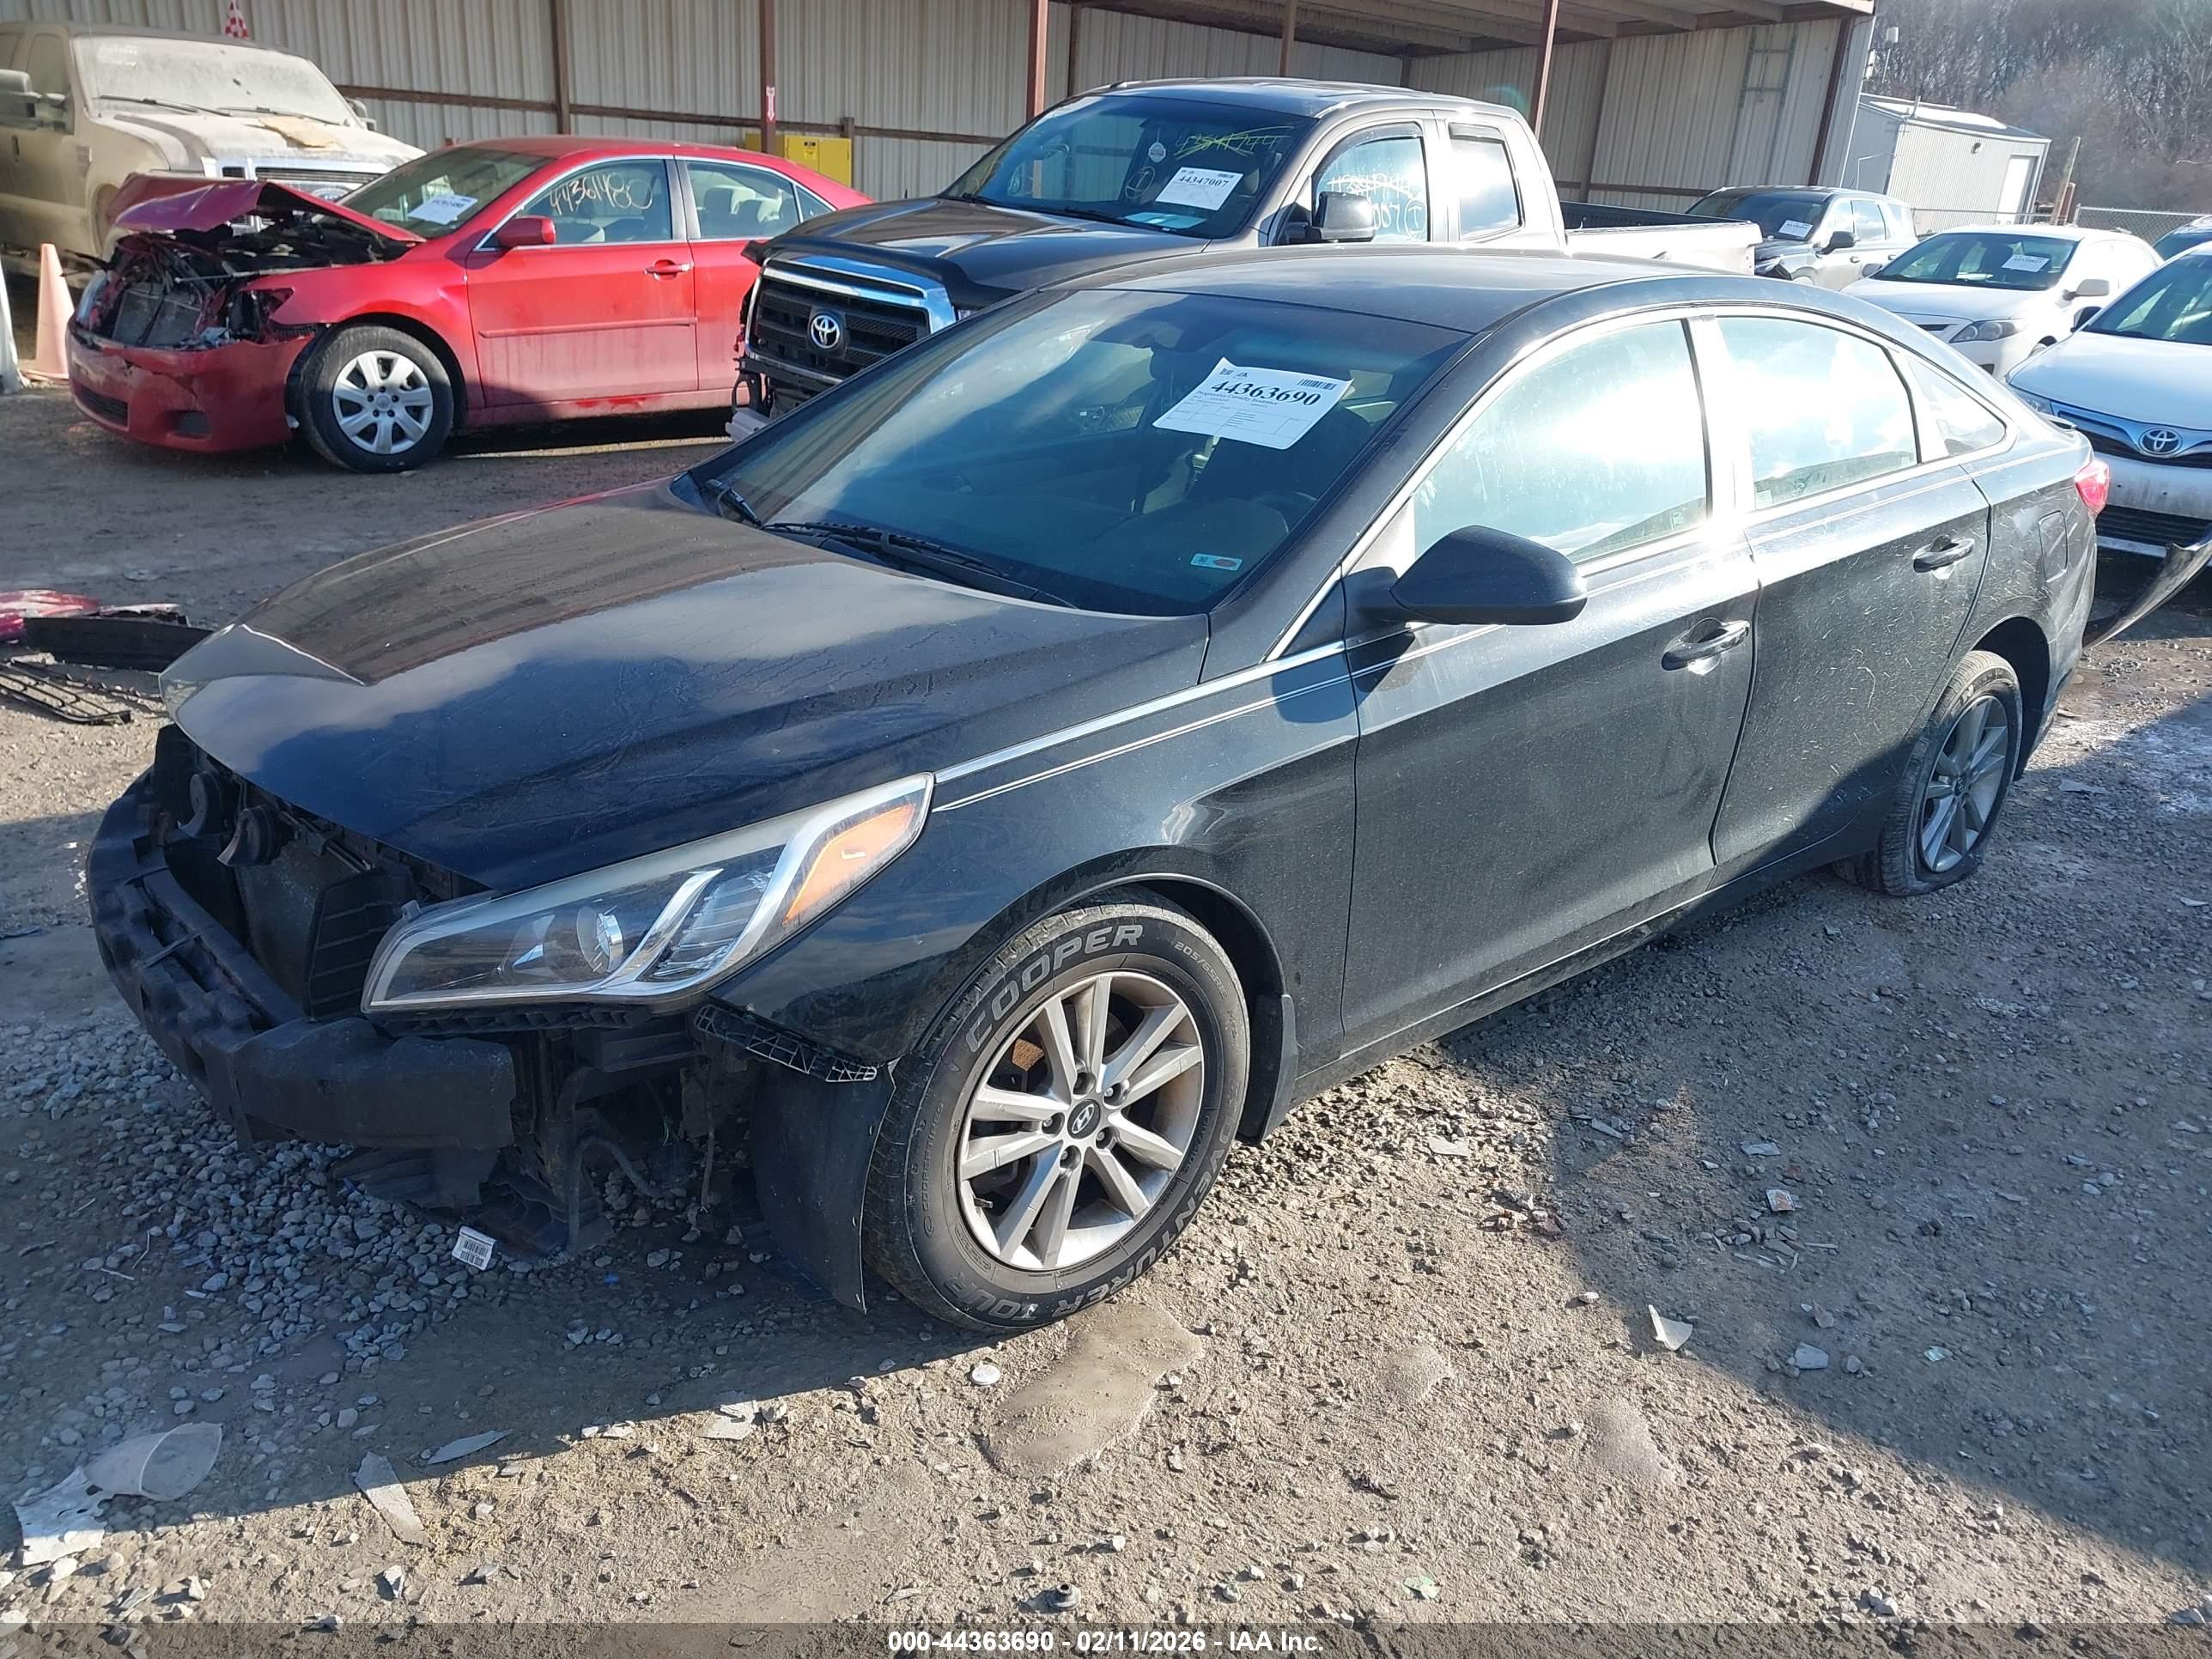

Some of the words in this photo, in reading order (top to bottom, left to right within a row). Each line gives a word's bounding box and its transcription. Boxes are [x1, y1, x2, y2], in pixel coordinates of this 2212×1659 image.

[1178, 174, 1229, 188] 44347007
[1211, 380, 1321, 406] 44363690
[965, 924, 1145, 1053] COOPER
